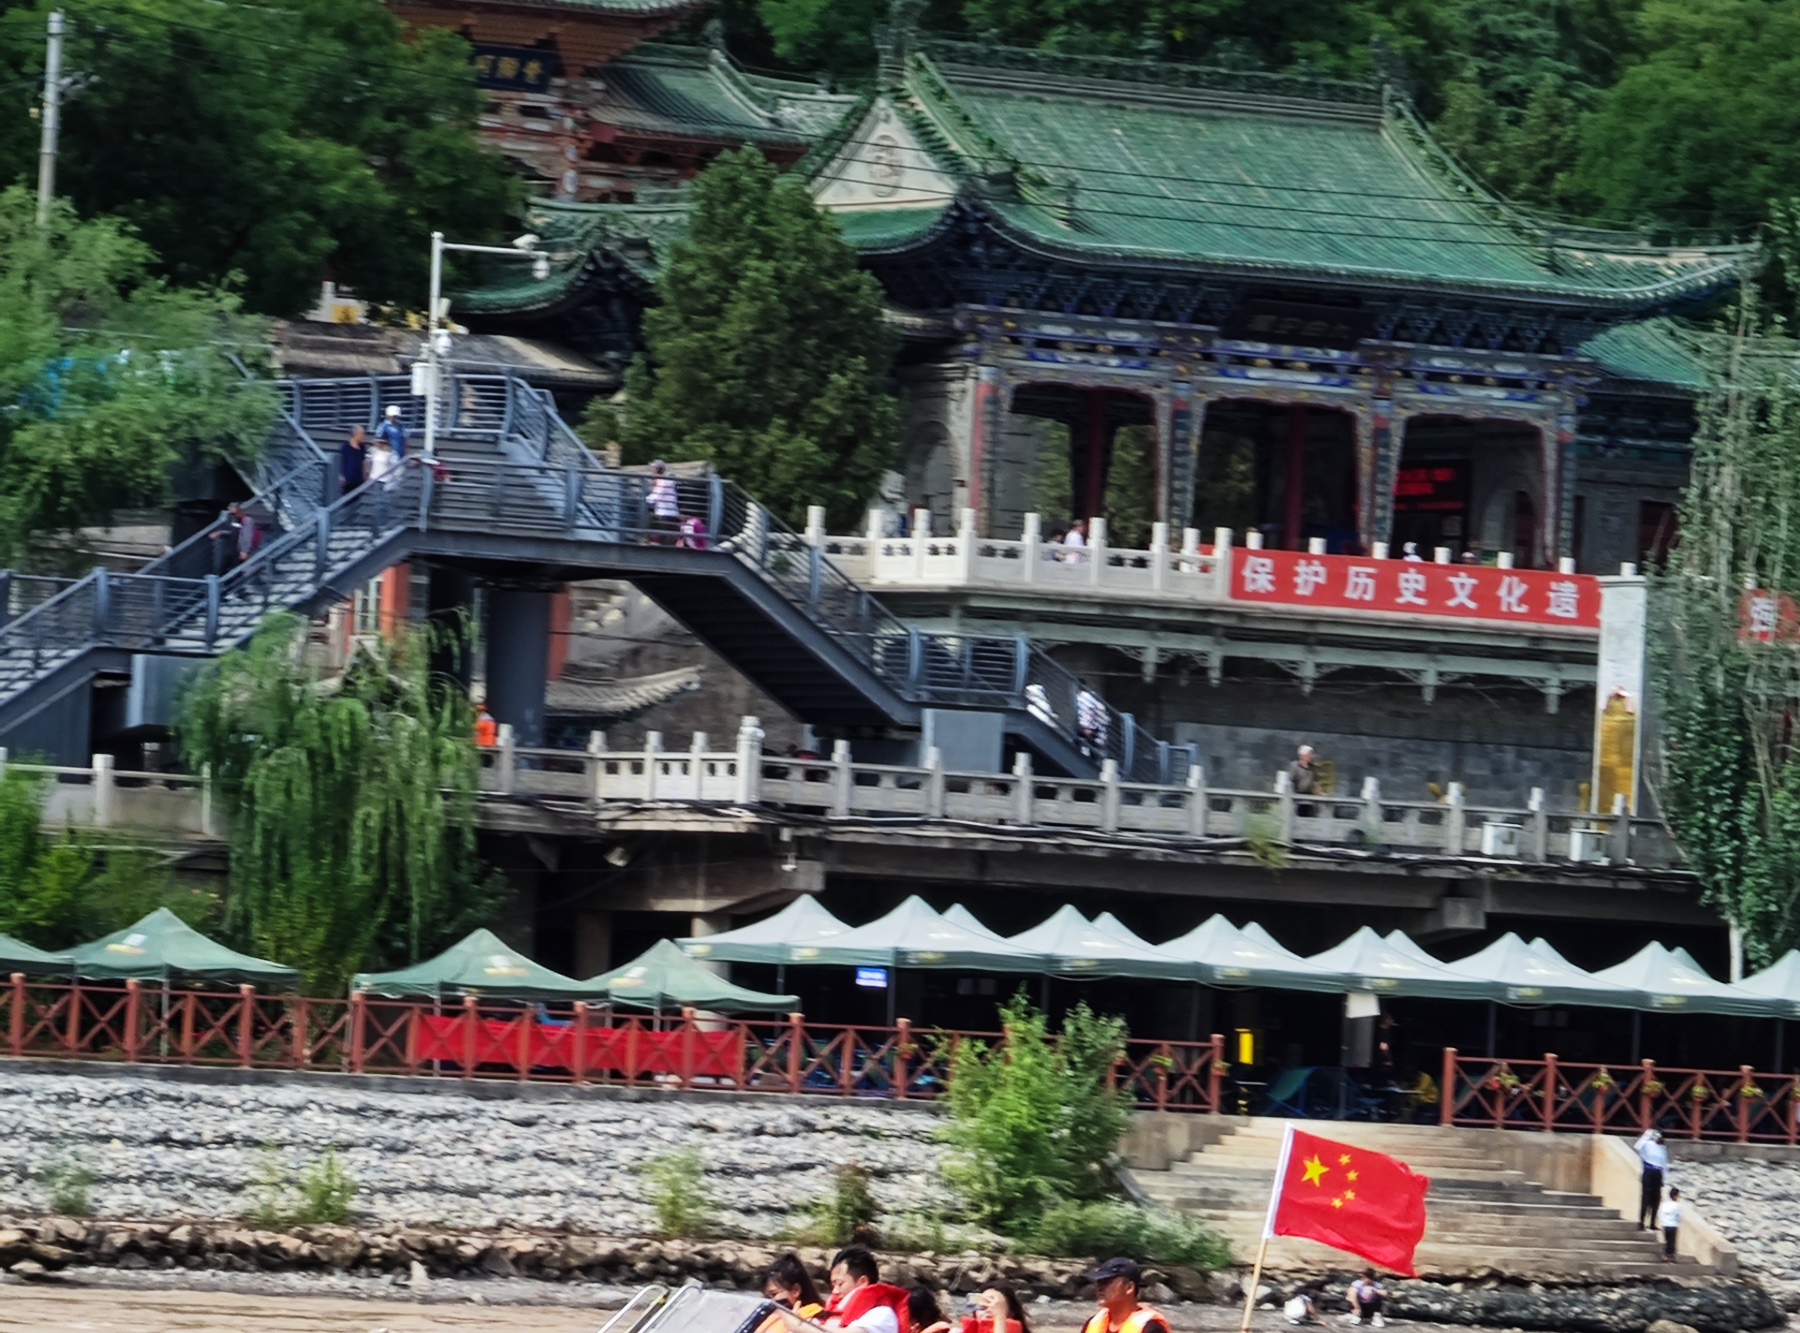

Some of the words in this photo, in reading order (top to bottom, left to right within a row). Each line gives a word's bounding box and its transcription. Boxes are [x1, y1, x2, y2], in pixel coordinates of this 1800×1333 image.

[1241, 555, 1602, 619] 保护历史文化遗
